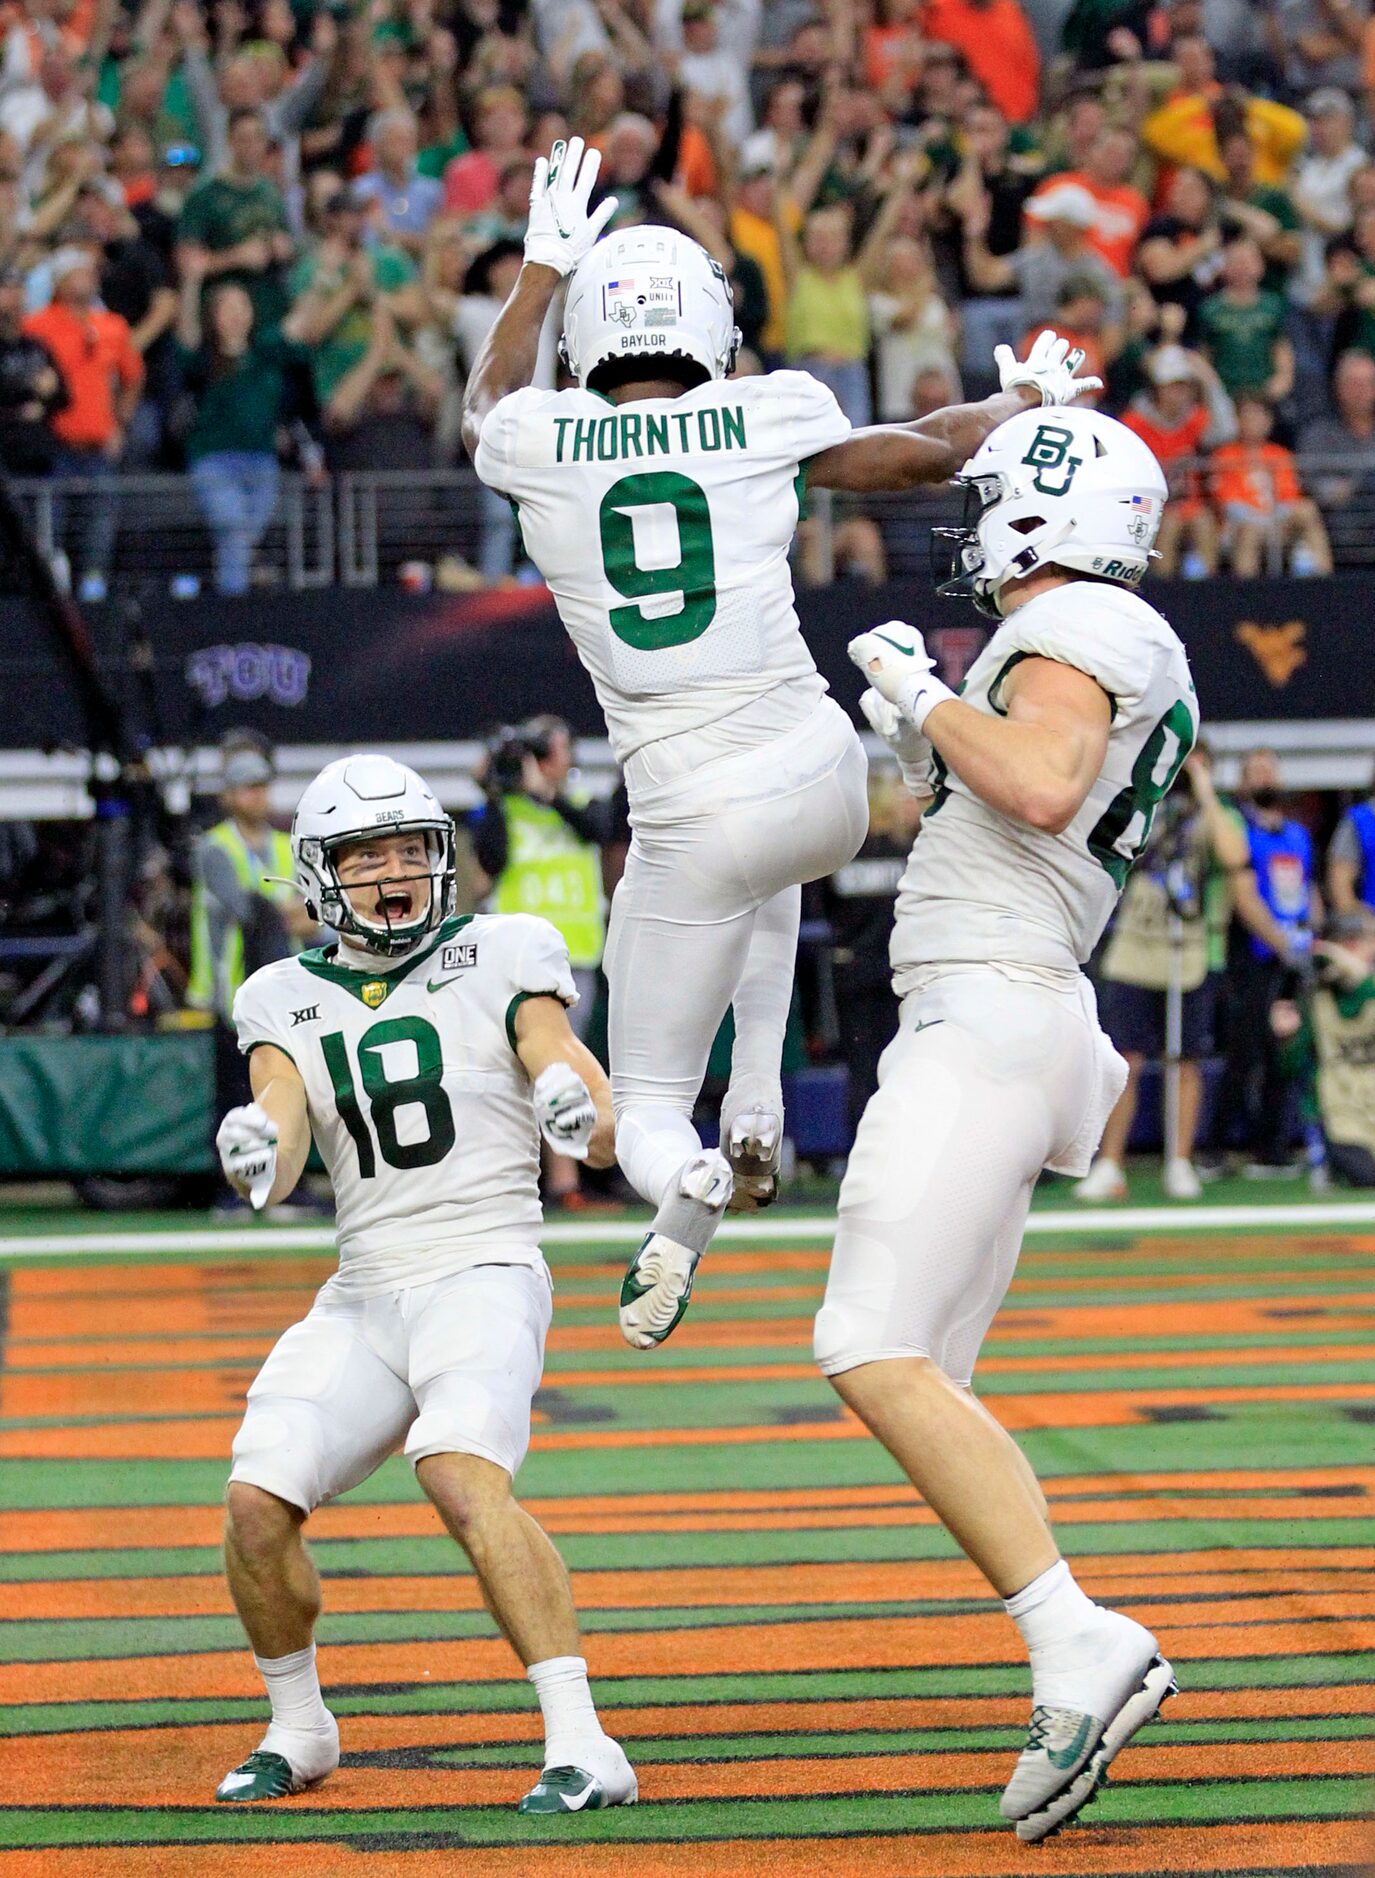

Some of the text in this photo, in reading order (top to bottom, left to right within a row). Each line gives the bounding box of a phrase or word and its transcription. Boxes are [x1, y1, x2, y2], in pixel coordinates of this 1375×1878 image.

[621, 334, 667, 349] BAYLOR
[553, 406, 748, 463] THORNTON
[1021, 424, 1083, 497] BU
[599, 470, 717, 651] 9
[375, 809, 405, 823] BEARS
[444, 945, 476, 964] ONE
[289, 1003, 322, 1028] XII
[320, 1015, 456, 1179] 18
